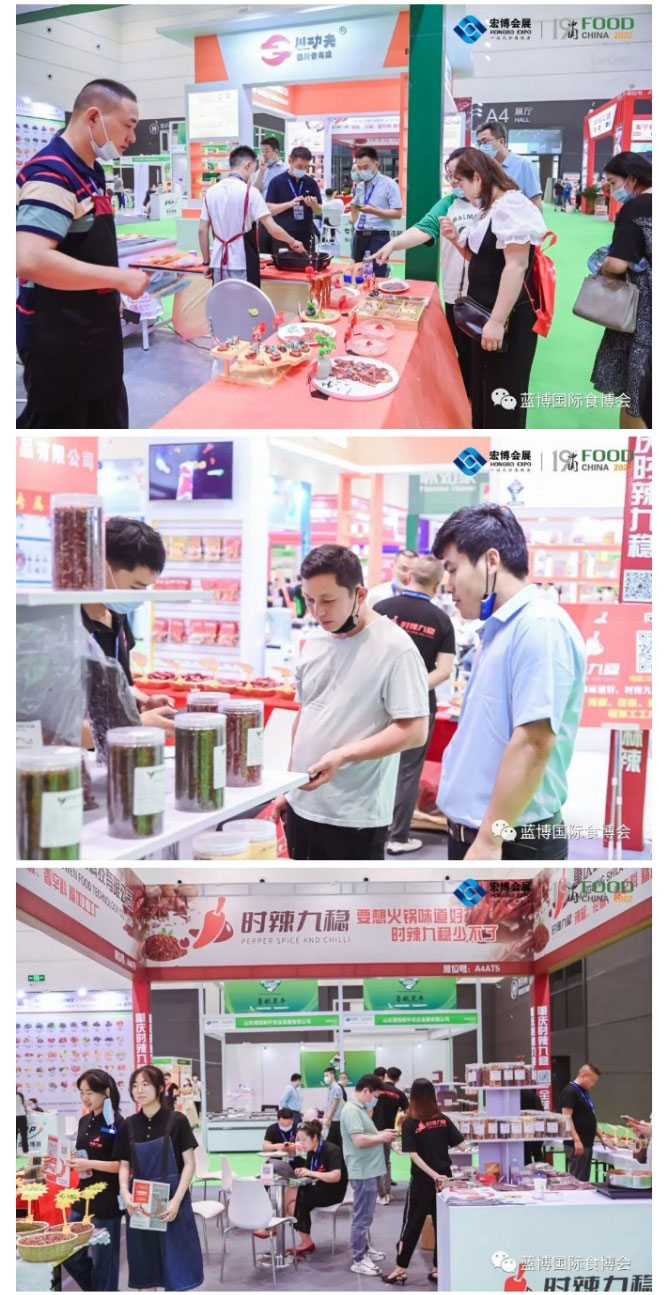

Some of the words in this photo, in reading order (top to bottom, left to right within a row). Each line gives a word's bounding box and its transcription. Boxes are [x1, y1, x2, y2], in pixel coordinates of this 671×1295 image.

[486, 108, 510, 122] A4
[514, 107, 532, 116] 展厅
[241, 910, 350, 934] 时辣九稳
[391, 924, 498, 942] 时辣九稳少不了
[475, 964, 500, 973] A4AT5
